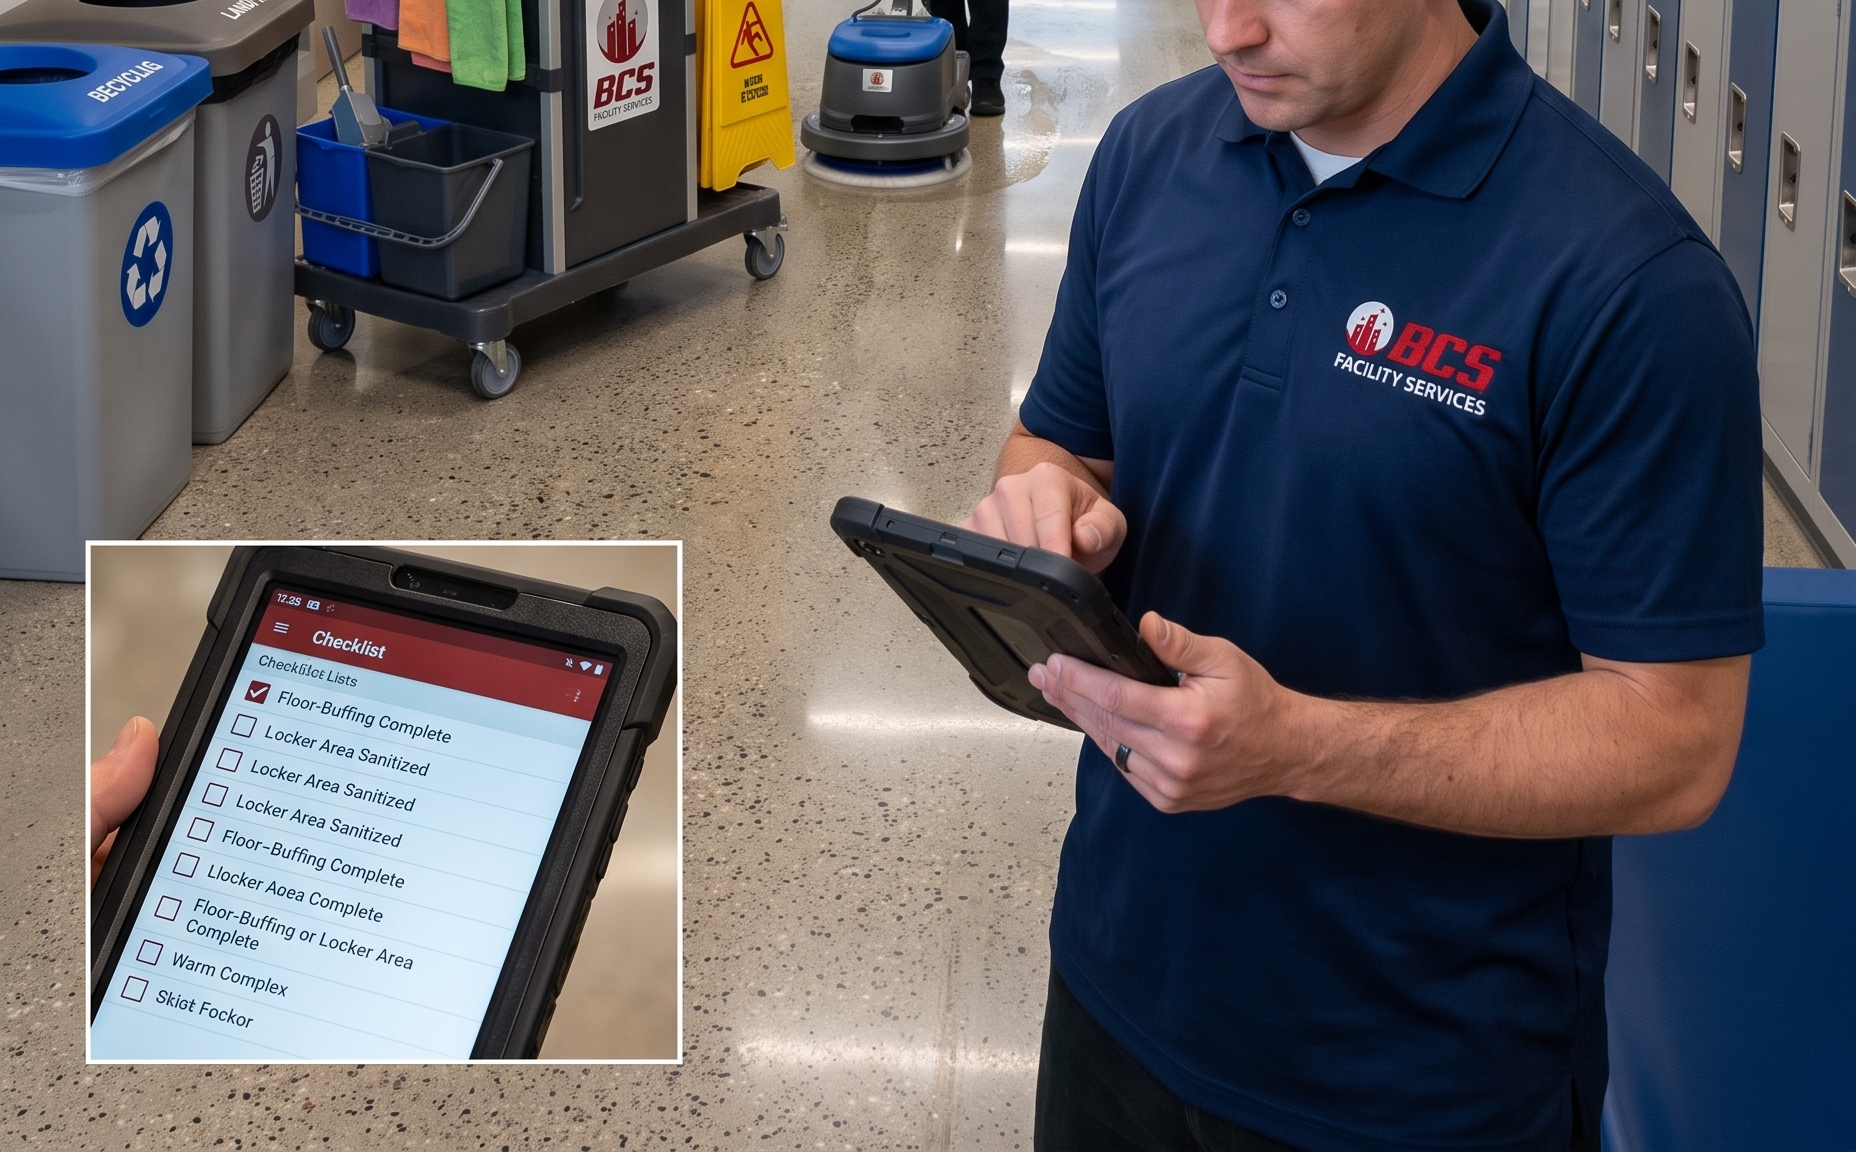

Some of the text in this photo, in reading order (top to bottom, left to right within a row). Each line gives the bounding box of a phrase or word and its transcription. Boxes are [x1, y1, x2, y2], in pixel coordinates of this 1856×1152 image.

[593, 61, 655, 110] BCS
[623, 96, 653, 113] SERVICES
[1386, 322, 1502, 393] BCS
[1333, 352, 1486, 416] FACILITY SERVICES
[312, 630, 387, 659] Checklist
[327, 670, 357, 687] Lists
[278, 691, 451, 743] Floor-Buffing Complete
[265, 725, 430, 776] Locker Area Sanitized
[251, 760, 416, 811] Locker Area Sanitized
[236, 794, 403, 847] Locker Area Sanitized
[222, 830, 404, 888] Floor-Buffing Complete
[208, 865, 264, 890] Llocker
[309, 892, 383, 922] Complete
[186, 919, 259, 950] Complete
[193, 898, 413, 970] Floor-Buffing or Locker Area
[173, 952, 288, 997] Warm Complex
[199, 1001, 253, 1028] Fockor
